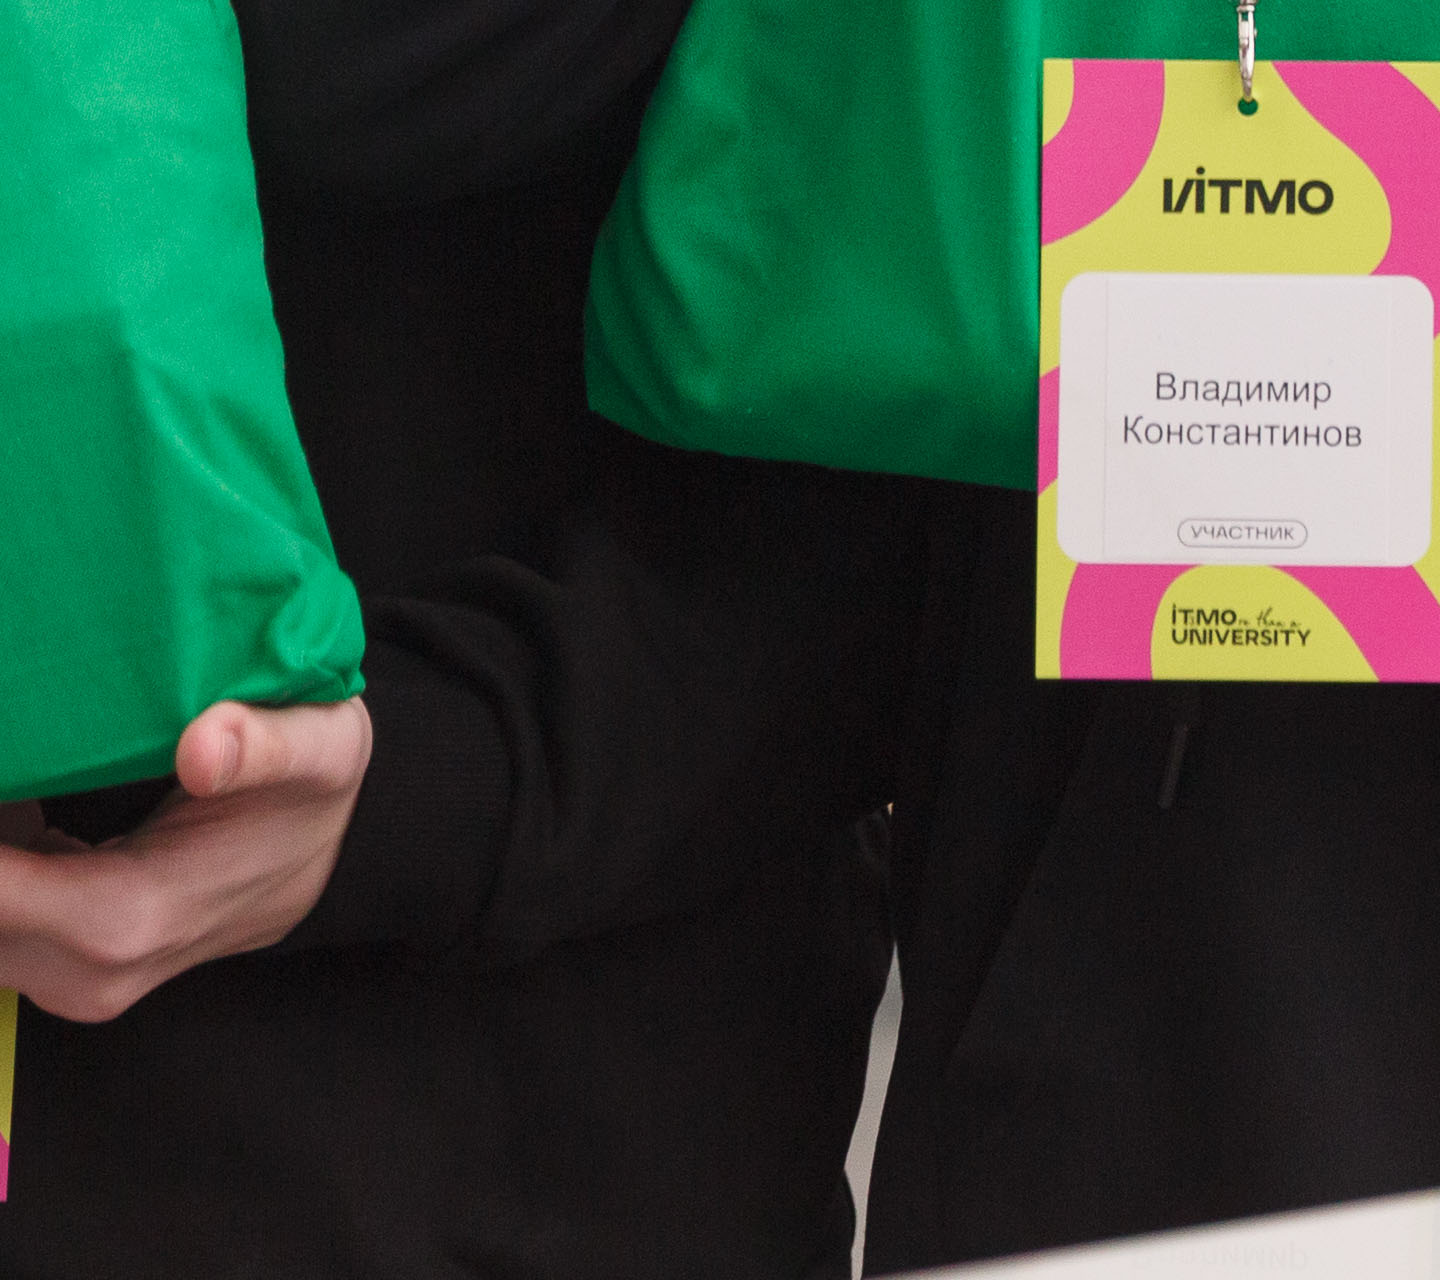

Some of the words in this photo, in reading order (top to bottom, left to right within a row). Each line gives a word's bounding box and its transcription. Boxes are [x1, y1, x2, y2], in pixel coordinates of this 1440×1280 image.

[1156, 372, 1332, 410] Владимир
[1123, 415, 1362, 447] Константинов
[1191, 525, 1294, 540] УЧАСТНИК
[1171, 628, 1311, 646] UNIVERSITY
